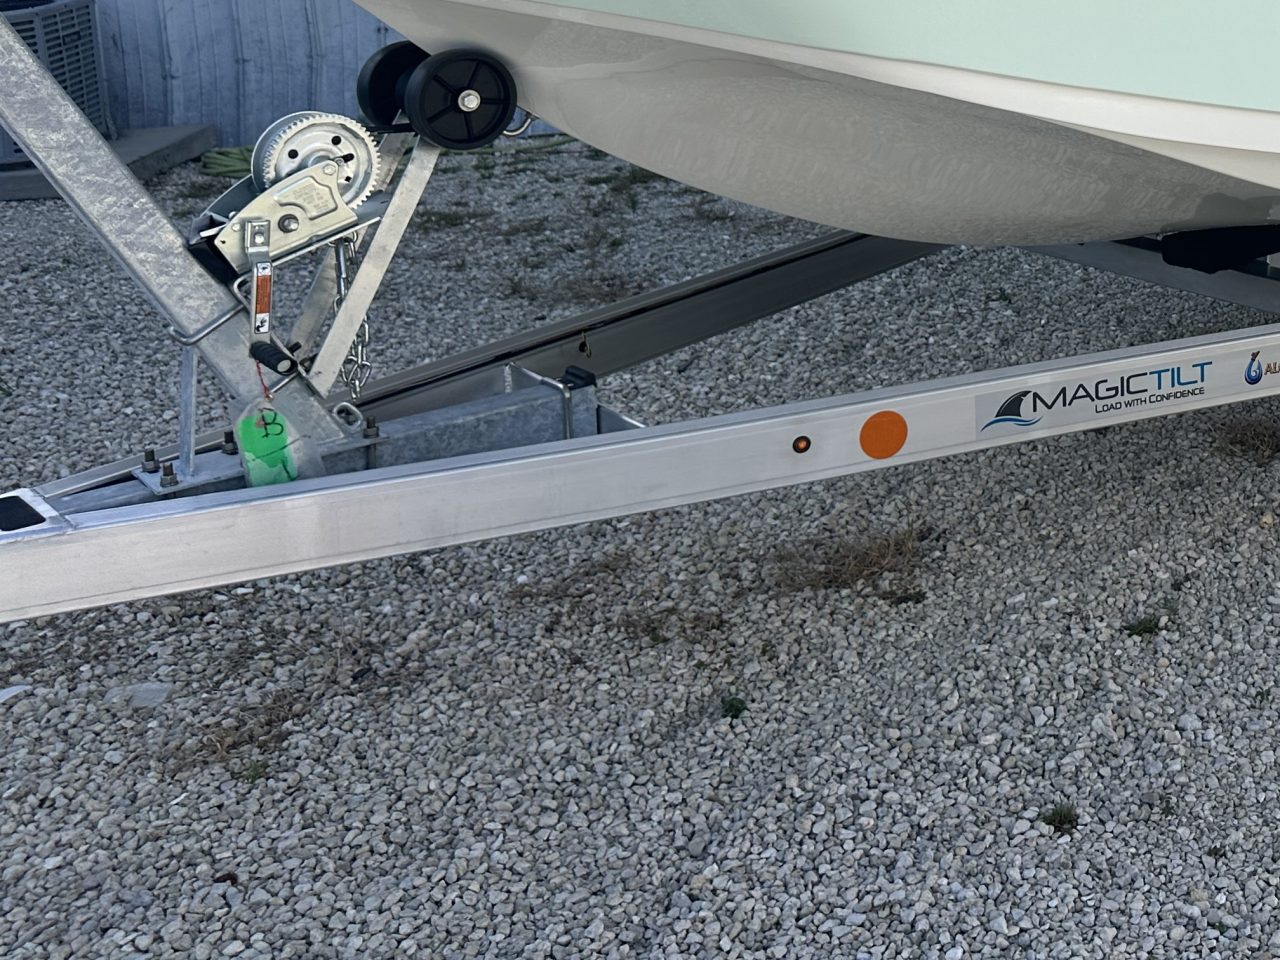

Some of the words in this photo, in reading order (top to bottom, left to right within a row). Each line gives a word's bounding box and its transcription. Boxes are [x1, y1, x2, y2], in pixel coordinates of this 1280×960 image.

[1032, 361, 1213, 413] MAGICTILT
[1095, 401, 1122, 414] LOAD
[1124, 396, 1147, 409] WITH
[1149, 386, 1206, 405] CONFIDENCE
